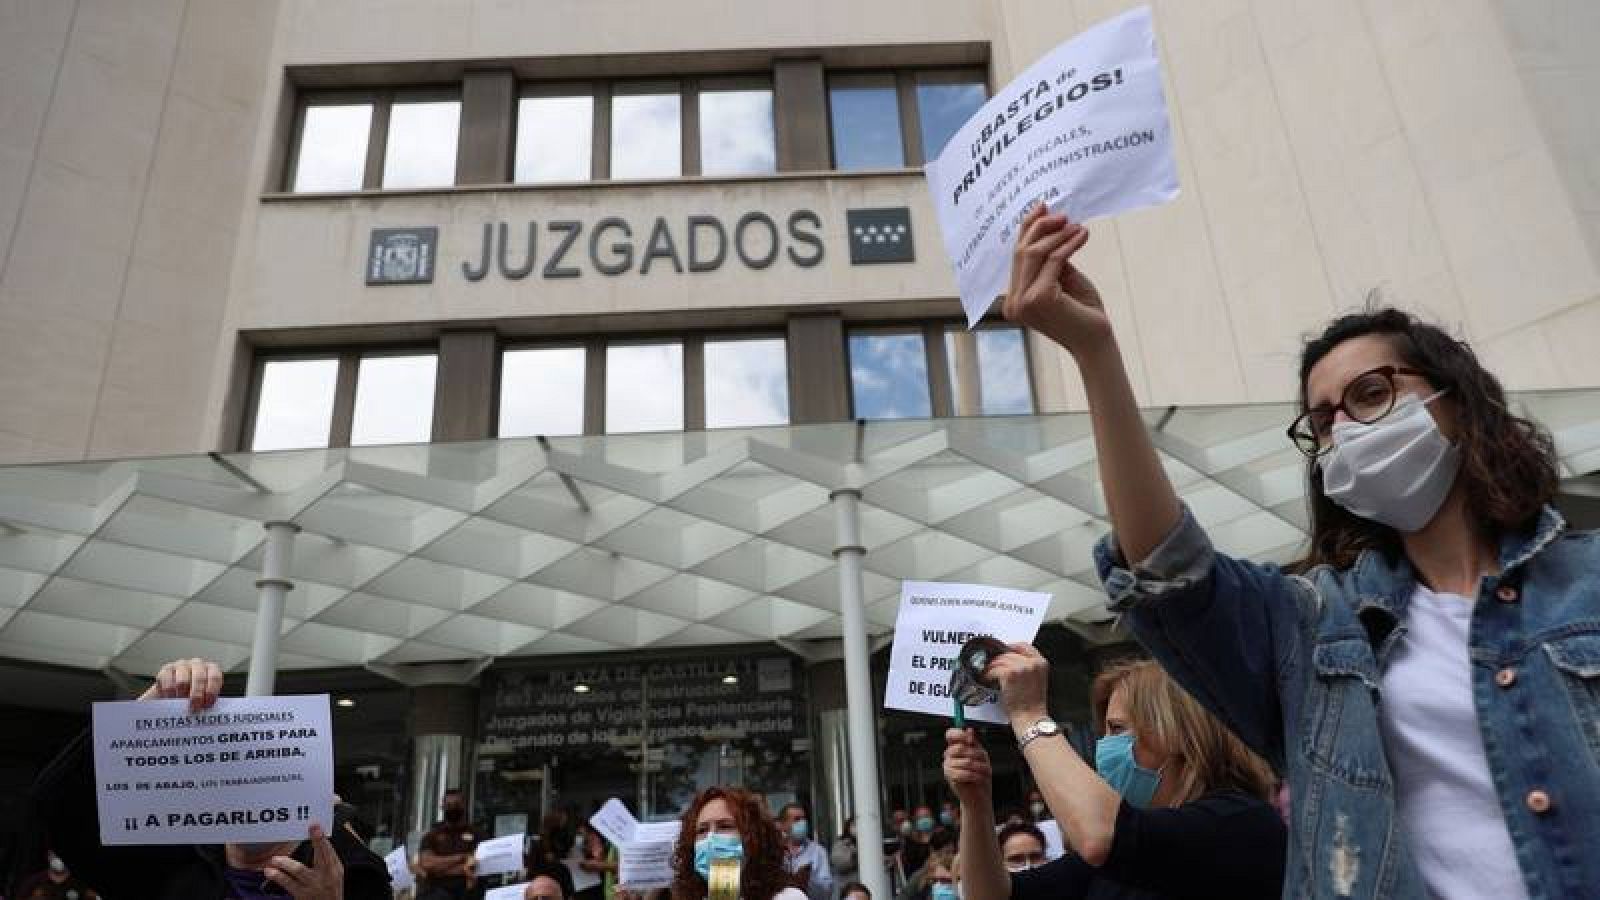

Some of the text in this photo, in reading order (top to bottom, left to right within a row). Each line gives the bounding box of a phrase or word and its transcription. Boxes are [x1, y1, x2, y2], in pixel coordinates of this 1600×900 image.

[1056, 66, 1077, 86] de
[953, 67, 1124, 205] PRIVILEGIOS!
[462, 209, 825, 283] JUZGADOS
[911, 655, 926, 669] EL
[909, 681, 925, 695] DE
[135, 711, 294, 731] EN ESTAS SEDES JUDICIALES
[570, 709, 592, 724] de
[110, 728, 318, 750] APARCAMIENTOS GRATIS PARA
[567, 730, 589, 744] de
[125, 753, 179, 767] TODOS
[184, 752, 215, 765] LOS
[220, 750, 240, 762] DE
[105, 783, 129, 791] LOS
[145, 814, 161, 827] A
[167, 807, 290, 827] PAGARLOS
[297, 805, 310, 820] !!
